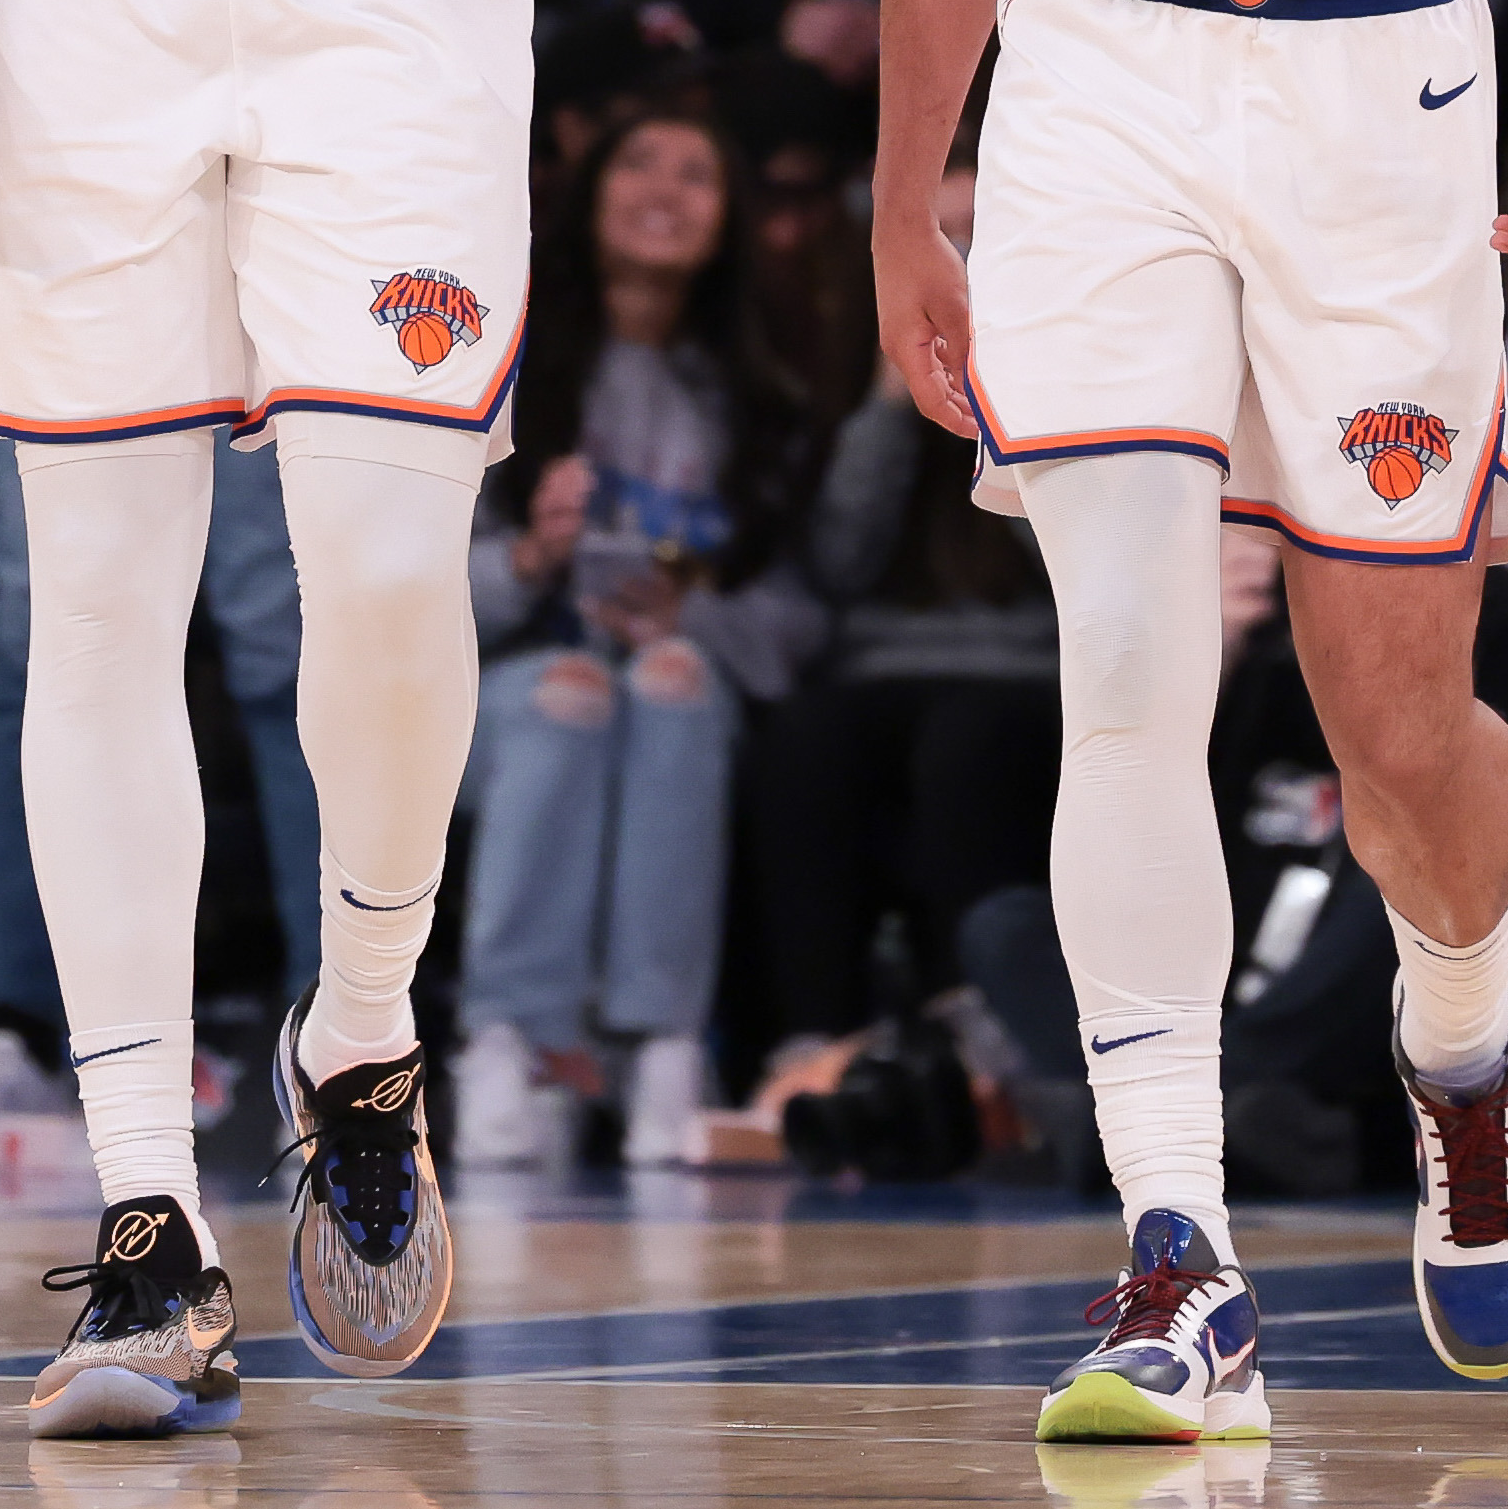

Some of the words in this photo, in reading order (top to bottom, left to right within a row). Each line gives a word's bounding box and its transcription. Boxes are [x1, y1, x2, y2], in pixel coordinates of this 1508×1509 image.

[413, 268, 437, 279] NEW
[438, 270, 462, 288] YORK
[370, 272, 482, 339] KNICKS
[1377, 402, 1400, 413] NEW
[1401, 403, 1426, 418] YORK
[1339, 408, 1452, 464] KNICKS
